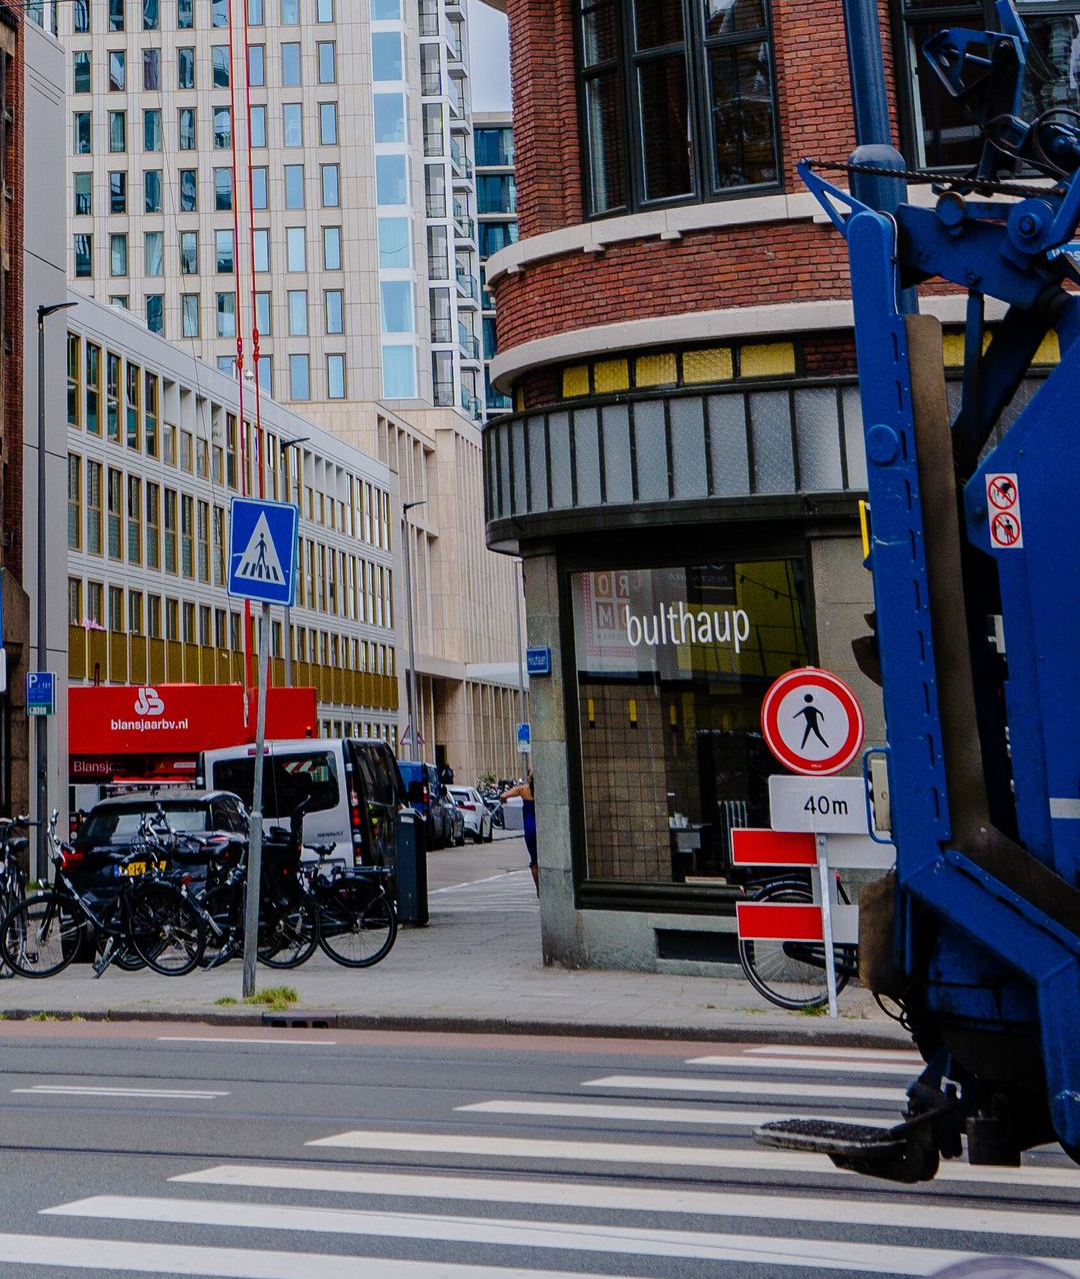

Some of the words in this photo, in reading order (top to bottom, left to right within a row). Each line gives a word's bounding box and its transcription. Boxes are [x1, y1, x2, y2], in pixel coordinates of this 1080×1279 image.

[625, 601, 750, 654] bulthaup
[110, 718, 189, 732] blansjaarbv.nl
[803, 795, 849, 815] 40m
